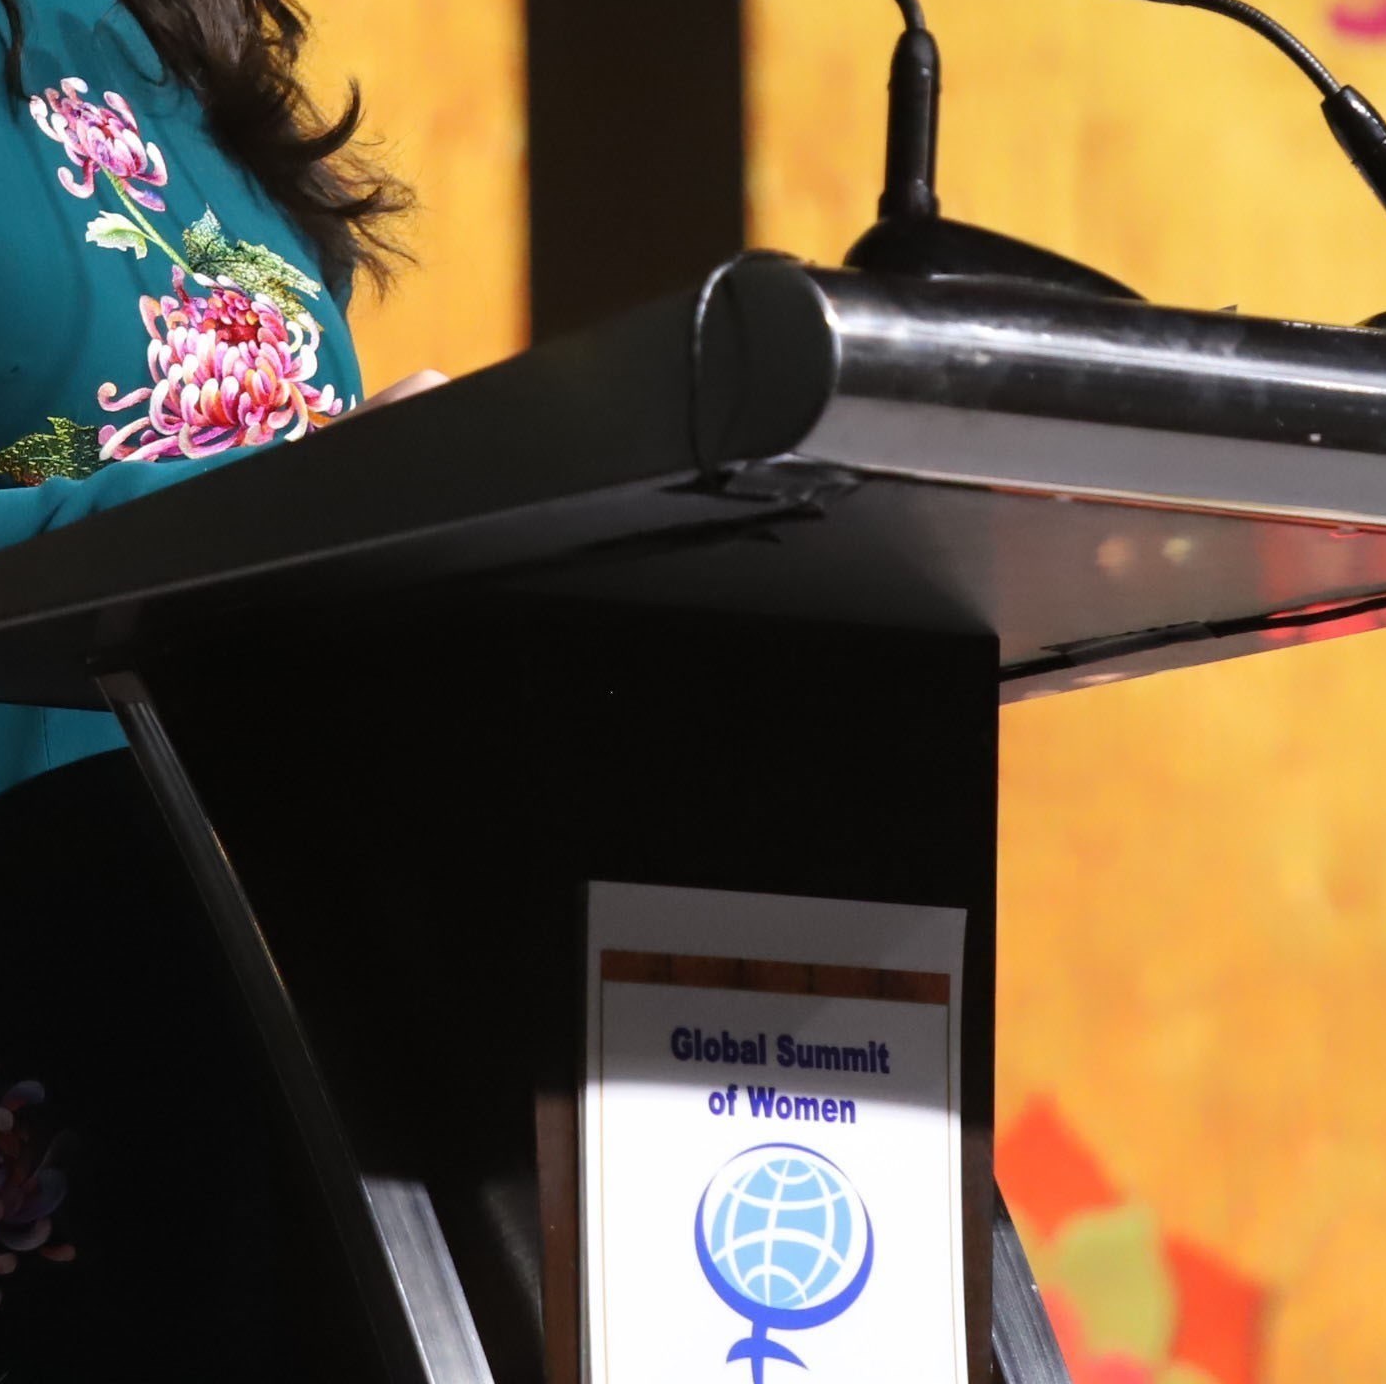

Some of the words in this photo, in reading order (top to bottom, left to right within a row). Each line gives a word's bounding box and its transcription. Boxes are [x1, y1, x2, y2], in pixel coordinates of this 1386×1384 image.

[670, 1026, 767, 1065] Global
[776, 1033, 891, 1074] Summit
[708, 1083, 738, 1116] of
[747, 1085, 857, 1124] Women
